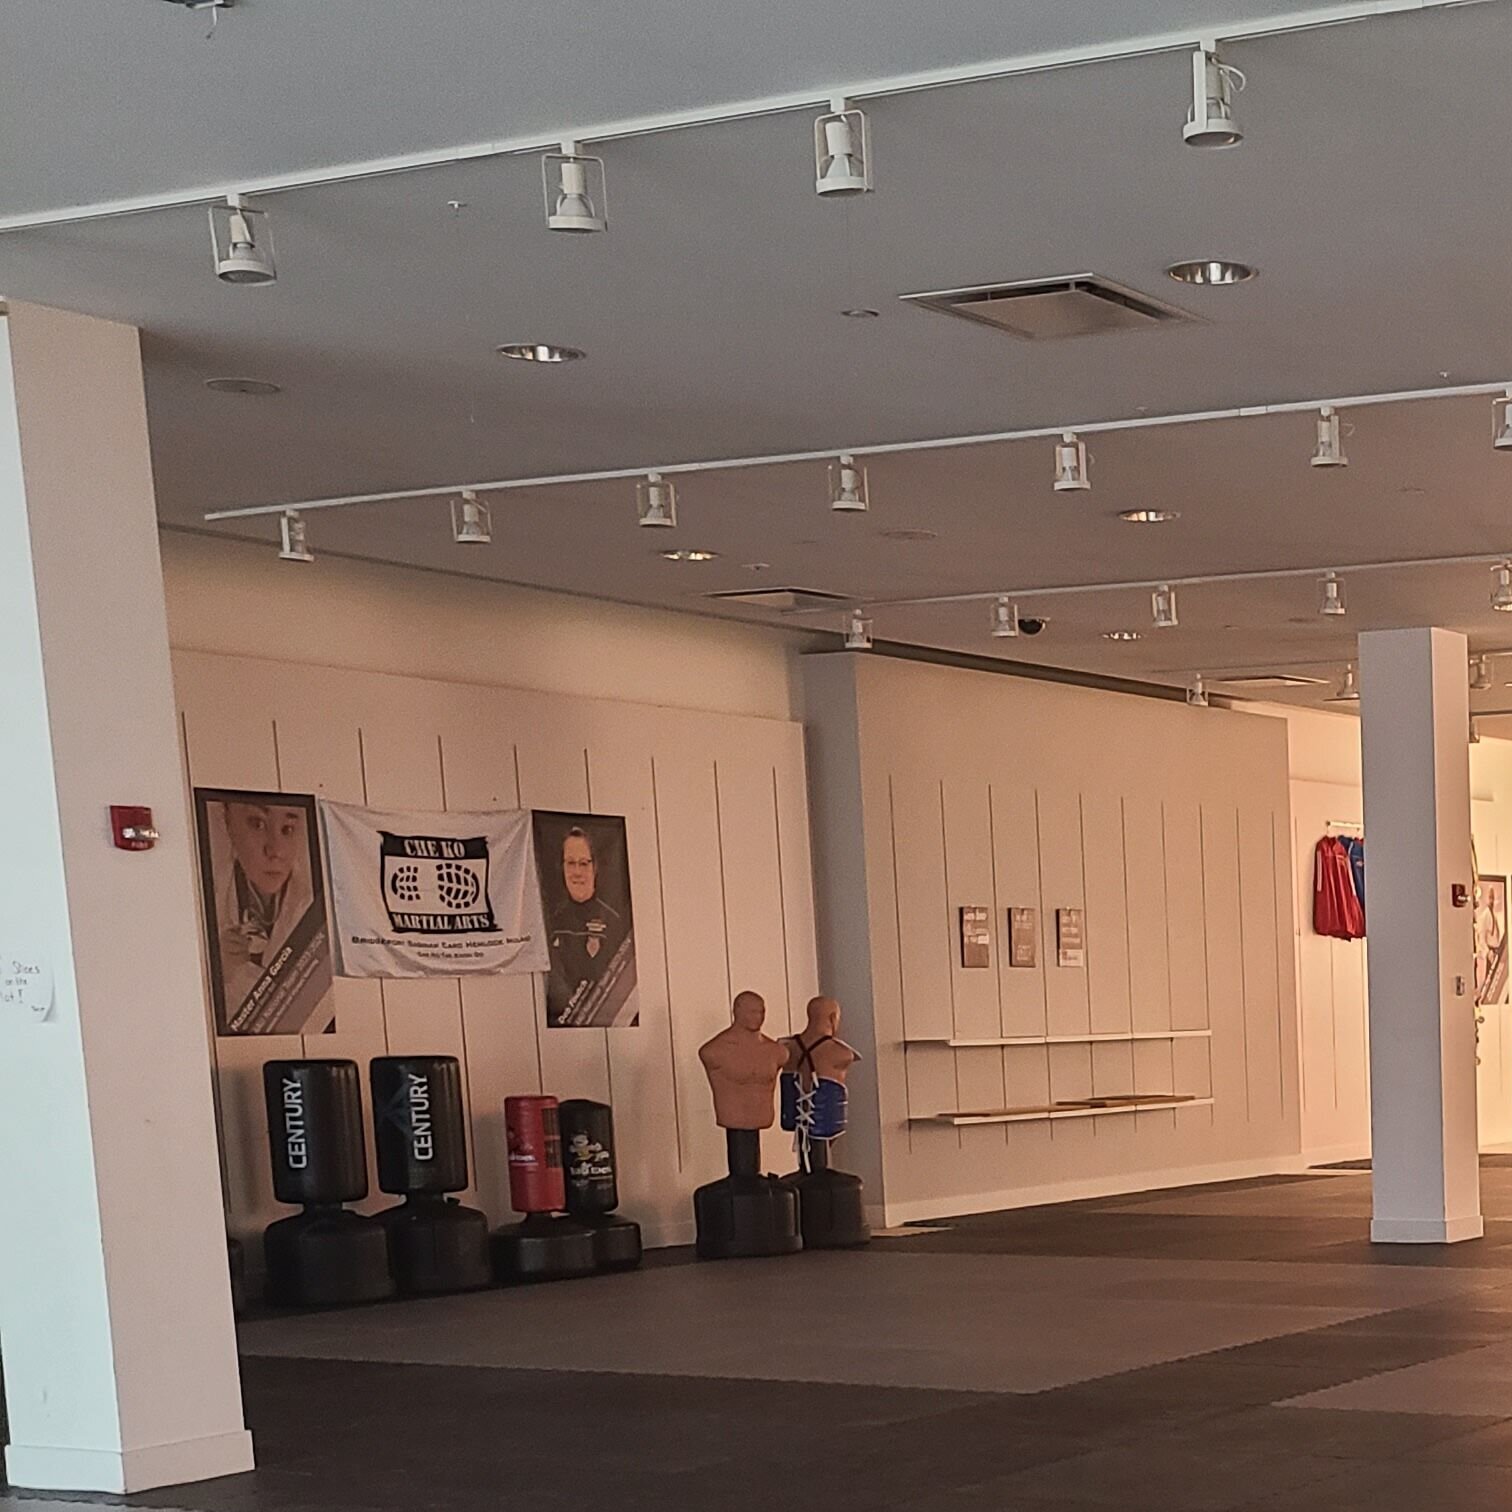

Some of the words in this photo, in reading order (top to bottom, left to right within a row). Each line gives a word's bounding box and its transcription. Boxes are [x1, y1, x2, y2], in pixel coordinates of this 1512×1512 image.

[391, 913, 451, 931] MARTIAL
[453, 914, 490, 930] ARTS
[230, 999, 255, 1032] Master
[253, 975, 273, 1001] Anna
[269, 946, 293, 977] Garcia
[282, 1078, 307, 1169] CENTURY
[407, 1073, 433, 1160] CENTURY
